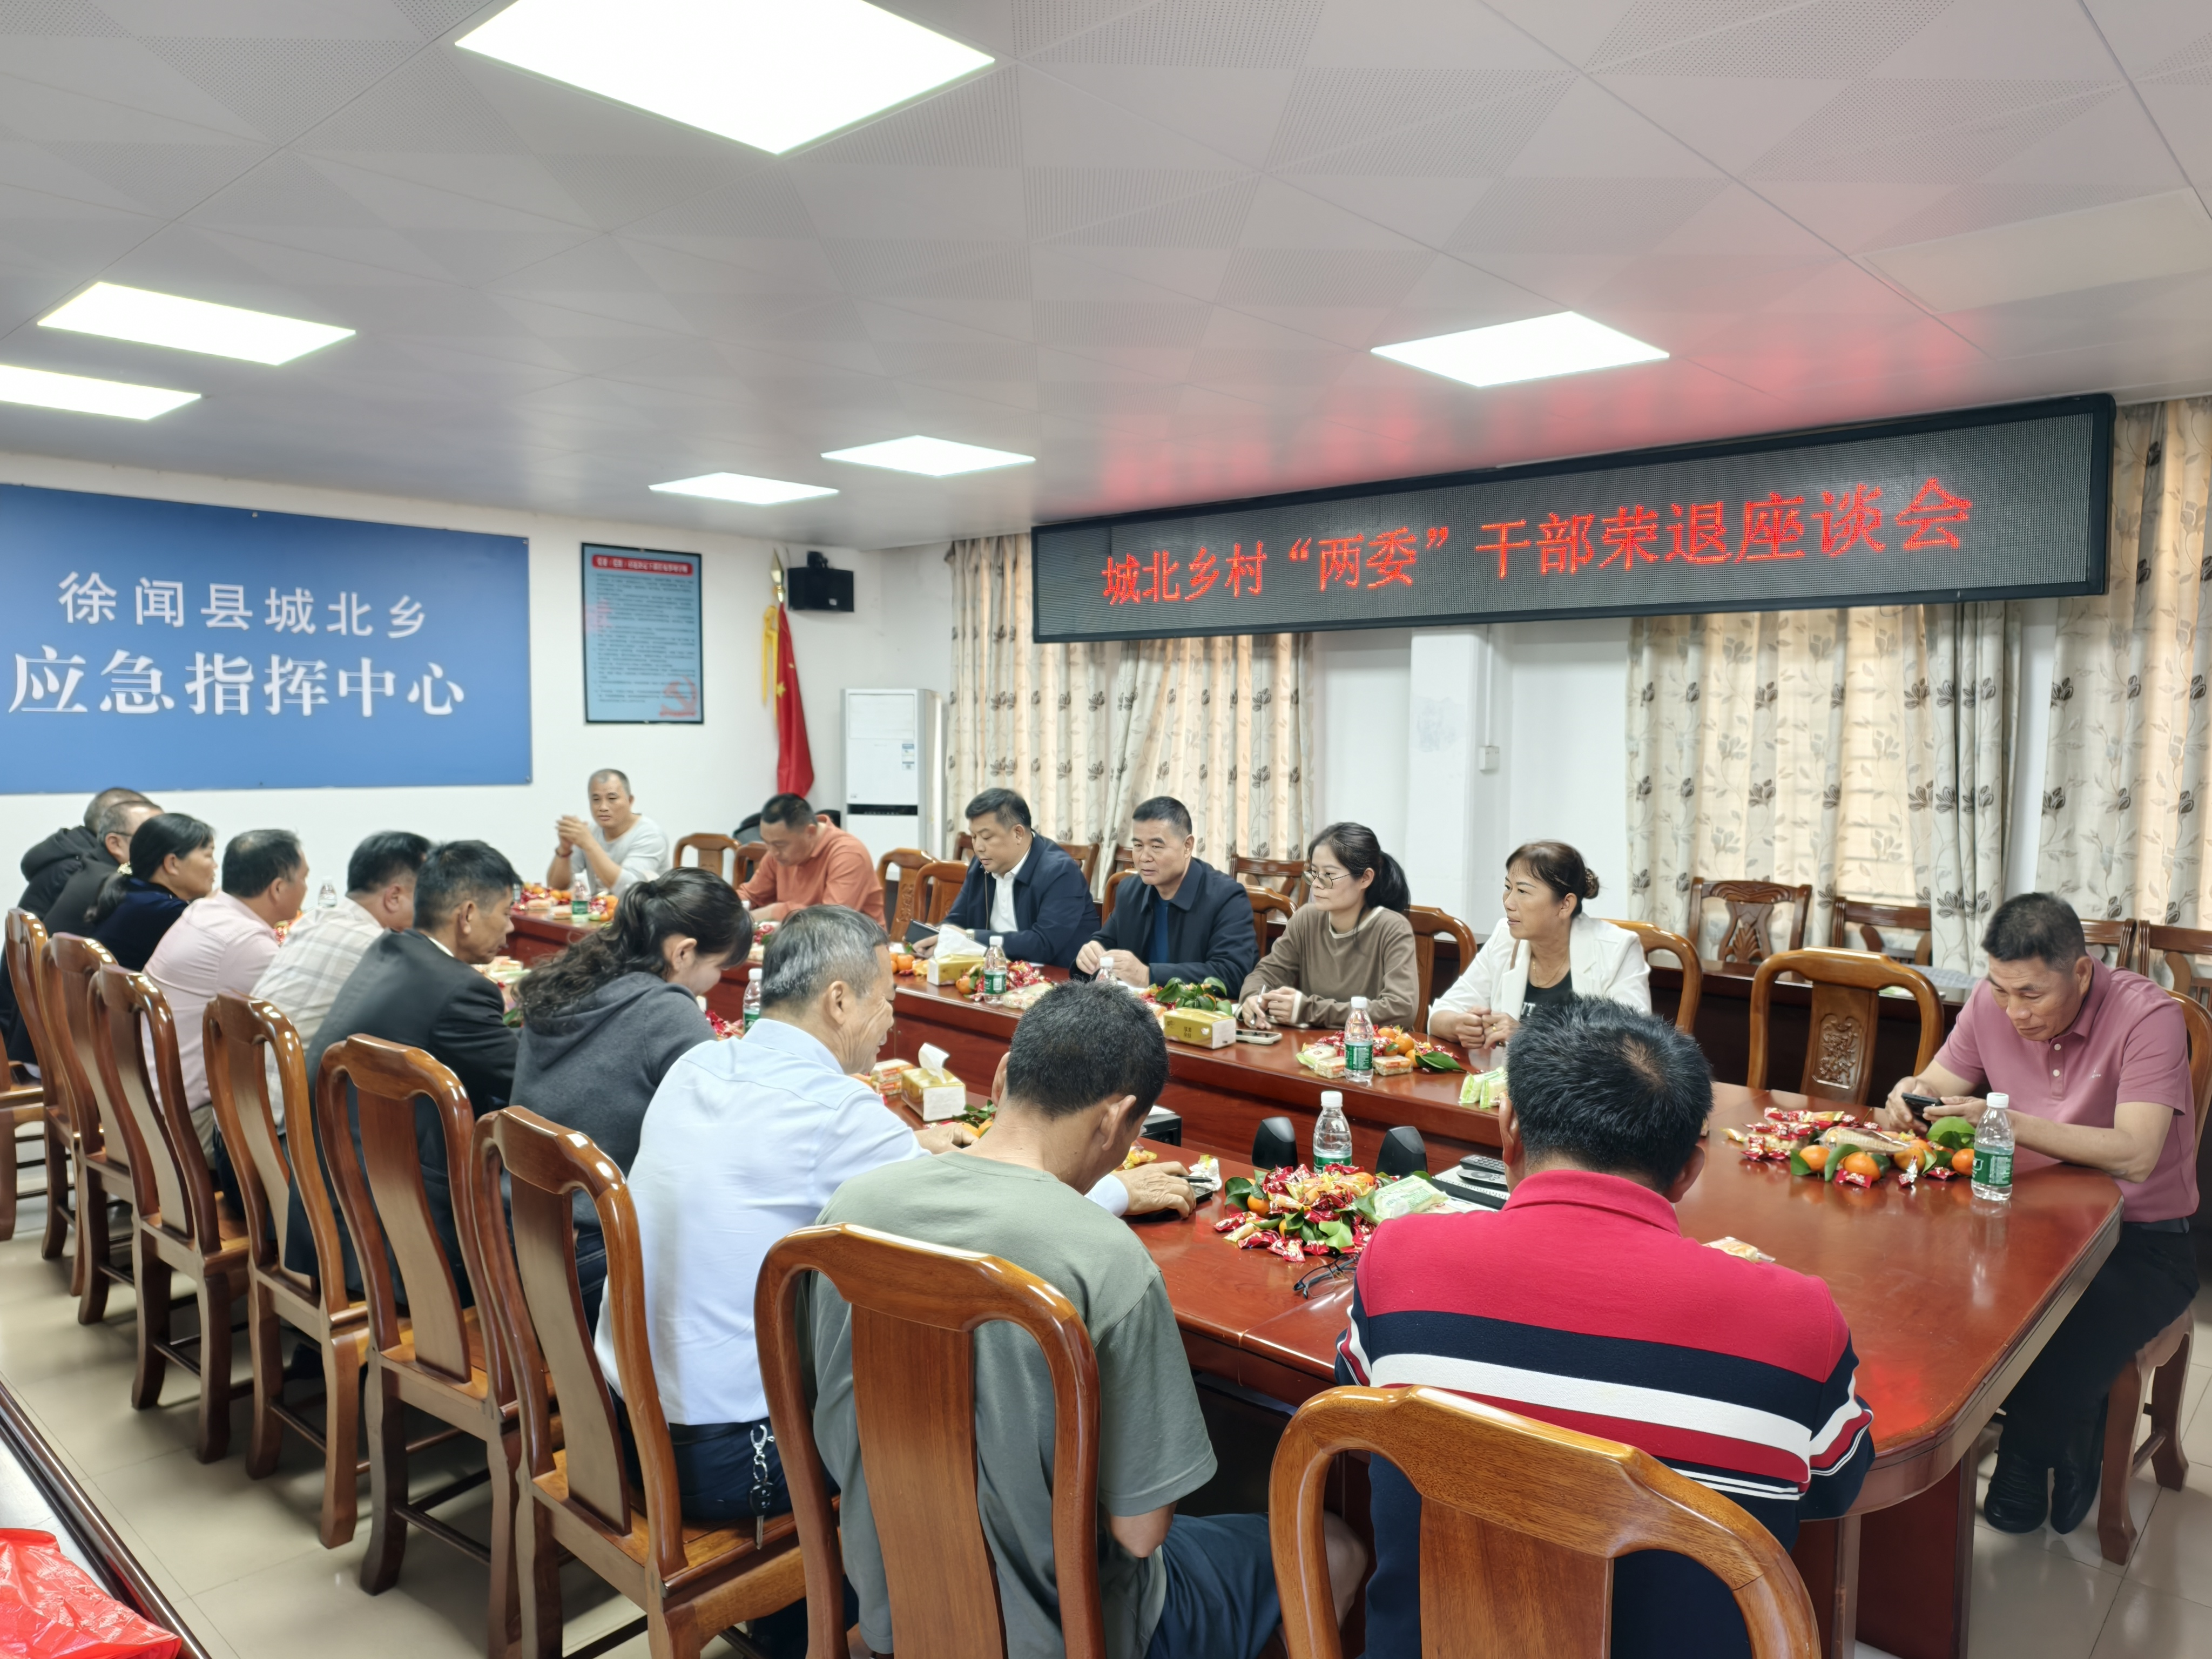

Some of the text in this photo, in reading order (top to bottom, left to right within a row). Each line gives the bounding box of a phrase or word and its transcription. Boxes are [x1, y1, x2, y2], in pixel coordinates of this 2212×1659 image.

[1101, 477, 1972, 605] 城北乡村“两委”干部荣退座谈会
[58, 571, 426, 638] 徐闻县城北乡
[9, 645, 465, 717] 应急指挥中心
